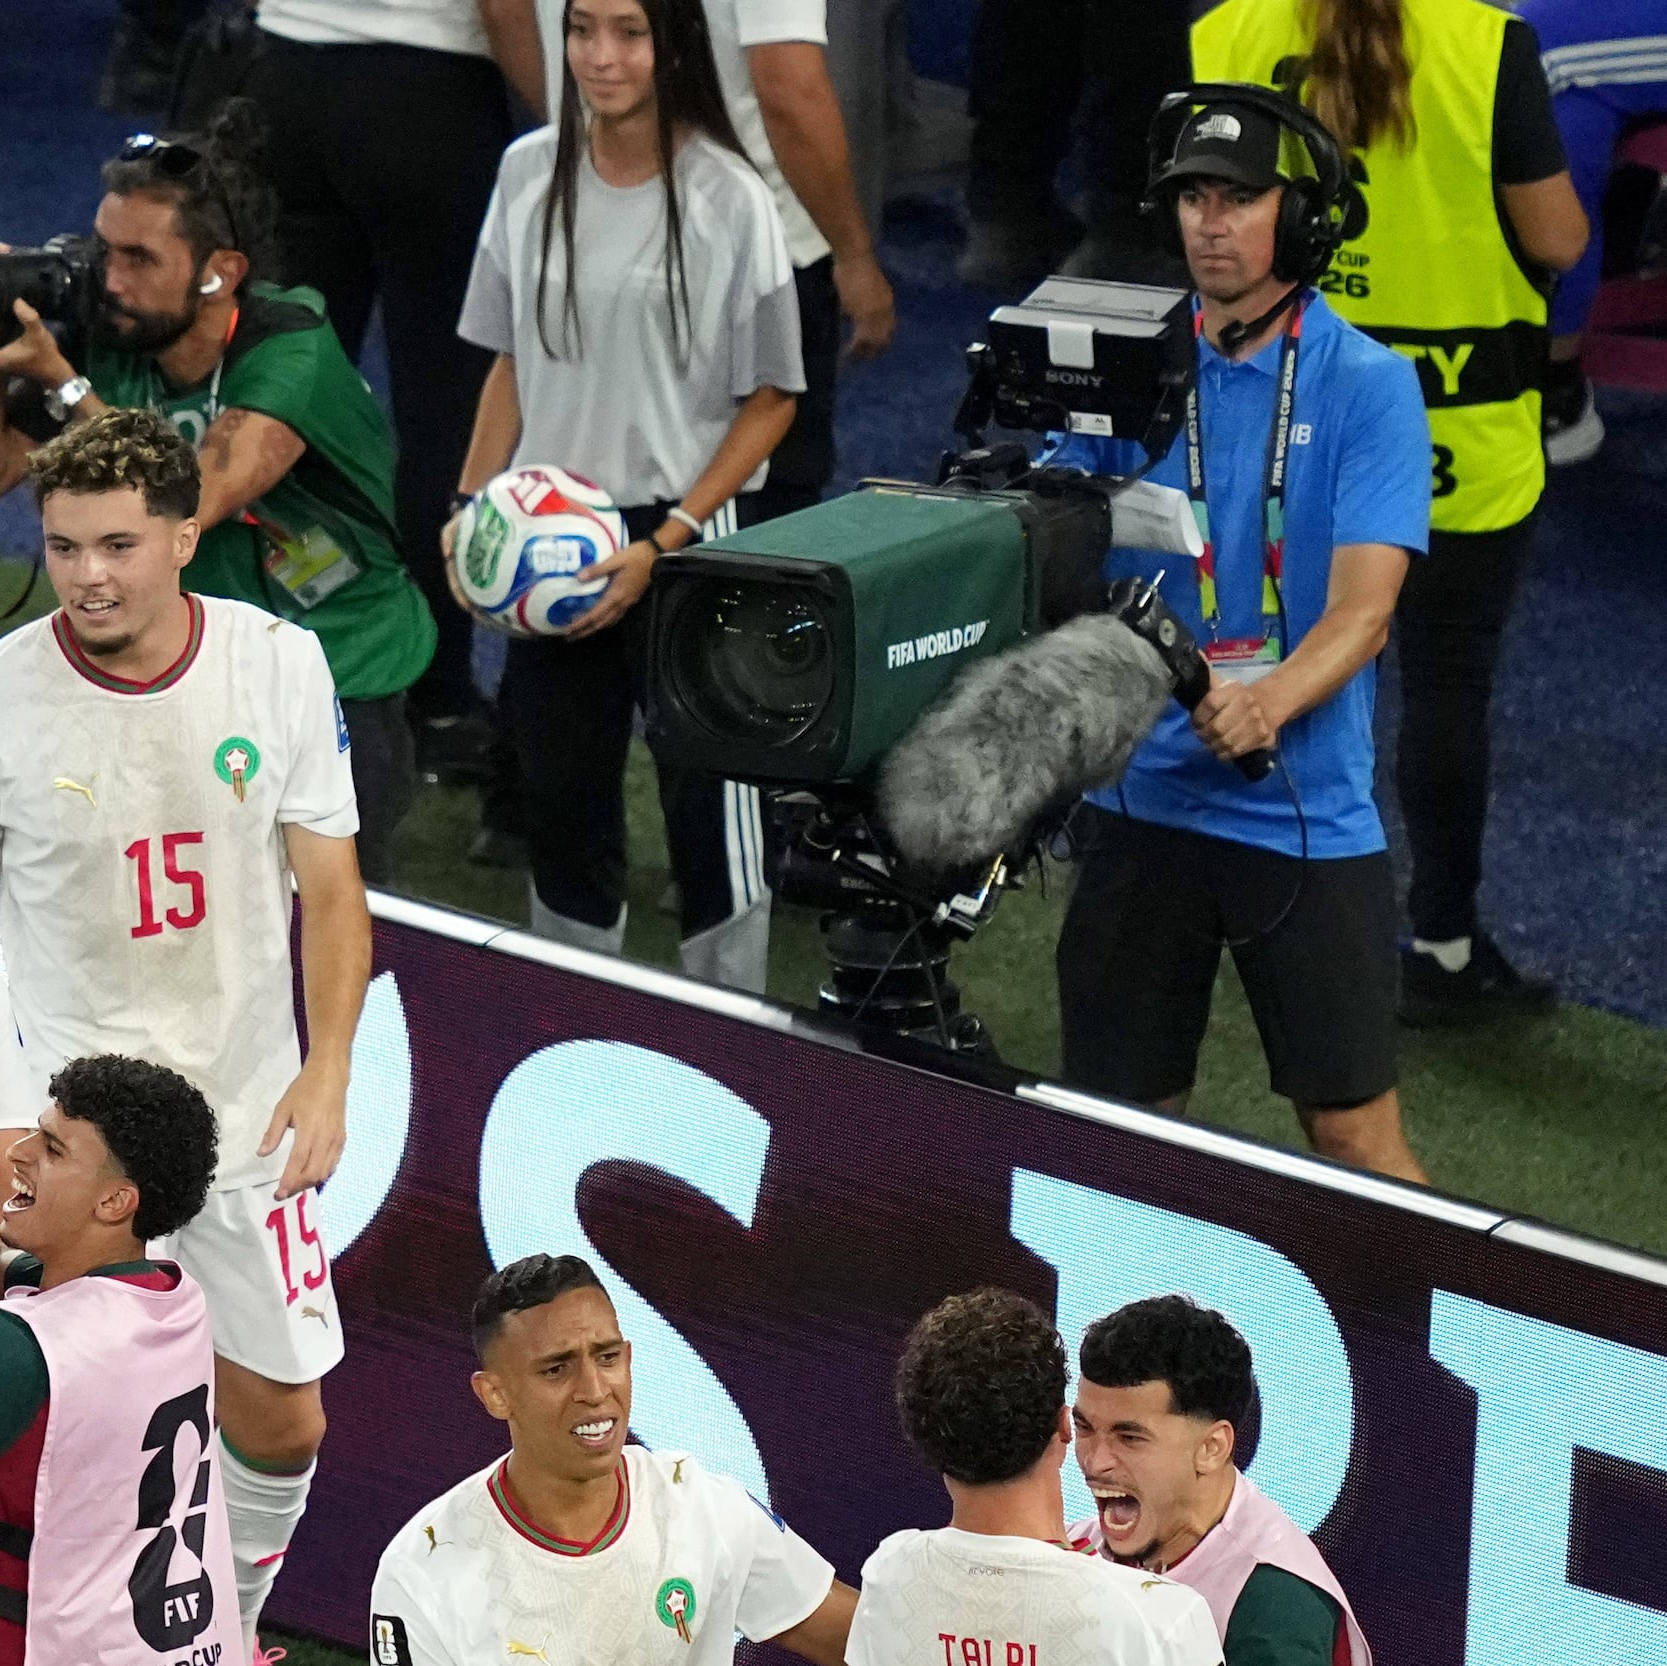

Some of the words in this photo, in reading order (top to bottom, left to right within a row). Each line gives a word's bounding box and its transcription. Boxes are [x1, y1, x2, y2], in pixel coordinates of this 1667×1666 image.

[1044, 370, 1105, 389] SONY
[887, 639, 916, 670] FIFA
[915, 627, 964, 661] WORLD
[963, 619, 987, 648] CUP
[124, 830, 206, 939] 15
[264, 1189, 328, 1305] 15
